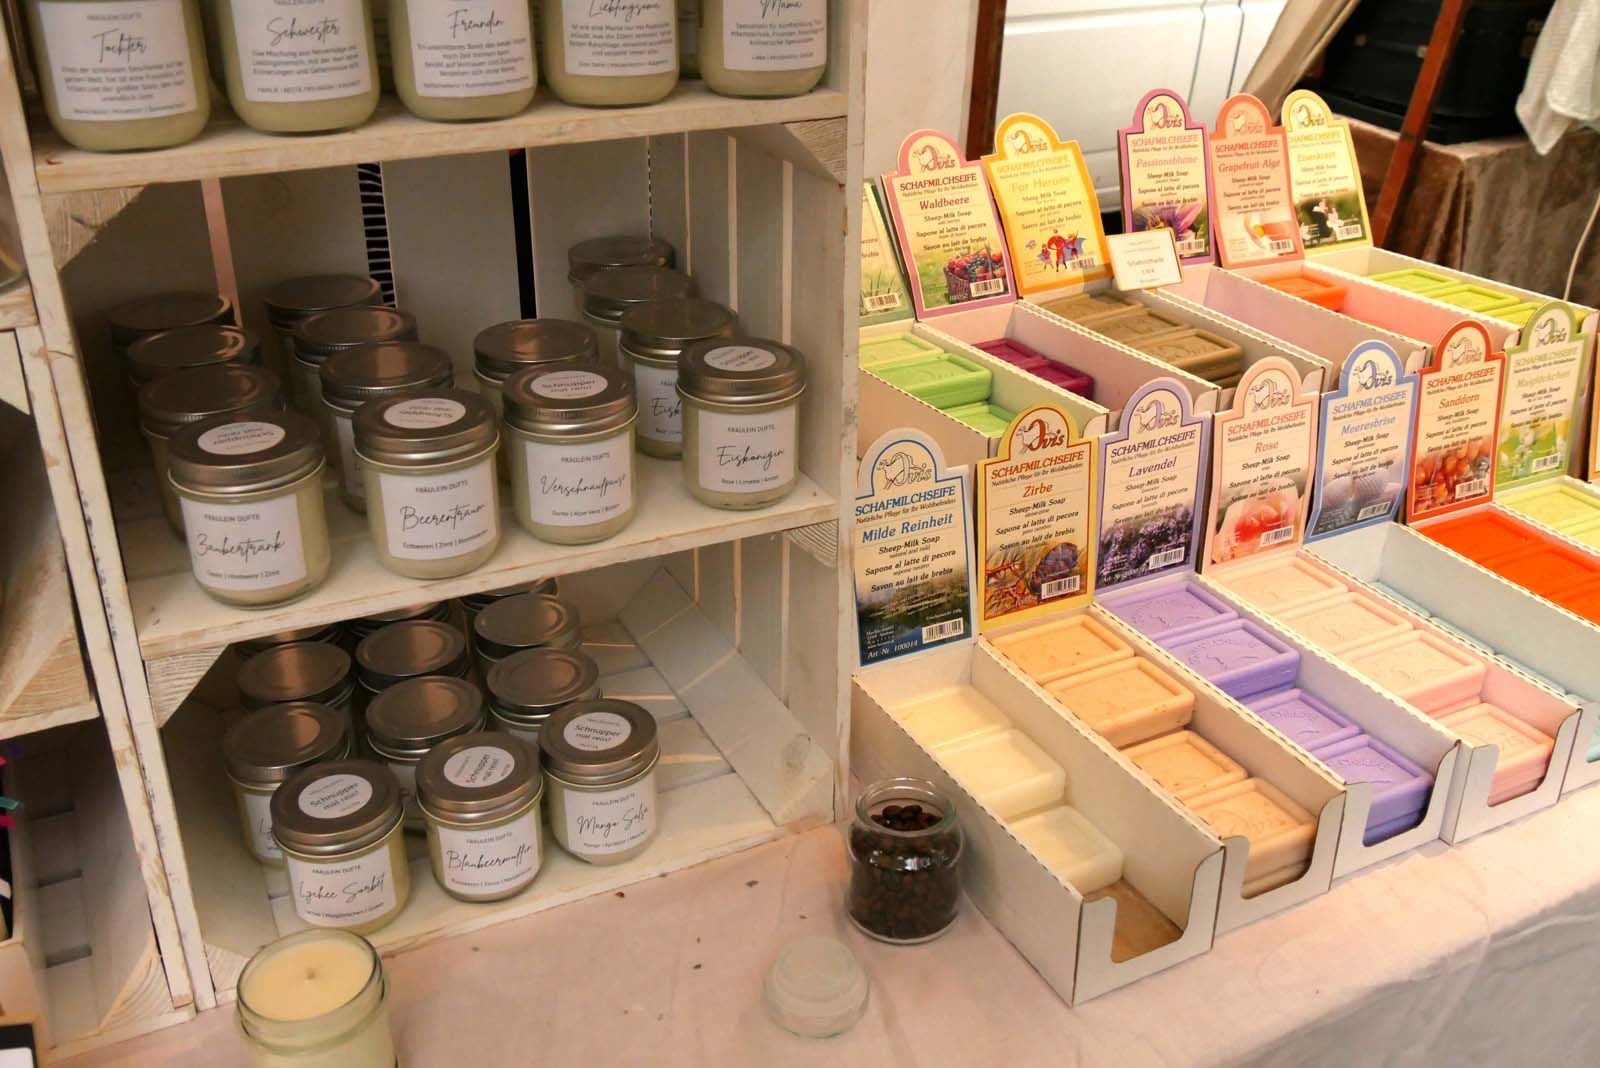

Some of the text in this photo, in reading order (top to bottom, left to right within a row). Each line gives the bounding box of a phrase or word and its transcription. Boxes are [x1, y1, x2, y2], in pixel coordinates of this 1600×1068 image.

[267, 17, 340, 47] Schwester
[448, 9, 505, 40] Freundin
[92, 28, 148, 62] Tochter
[1156, 103, 1182, 129] Ovis
[1299, 104, 1325, 127] Ovis
[1015, 130, 1048, 154] Ovis
[1131, 134, 1200, 147] SCHAFMILCHSEIFE
[1215, 140, 1278, 154] SCHAFMILCHSEIFE
[919, 145, 956, 172] Ovis
[996, 154, 1070, 173] SCHAFMILCHSEIFE
[1218, 160, 1260, 173] Grapefruit
[900, 173, 977, 192] SCHAFMILCHSEIFE
[919, 196, 970, 211] Waldbeere
[1540, 318, 1567, 346] Ovis
[1514, 347, 1578, 367] SCHAFMILCHSEIFE
[1362, 360, 1392, 390] Ovis
[1426, 366, 1496, 390] SCHAFMILCHSEIFE
[1259, 379, 1290, 410] Ovis
[1332, 390, 1407, 415] SCHAFMILCHSEIFE
[1439, 394, 1480, 409] Sanddorn
[756, 424, 775, 432] DUFTE
[1145, 400, 1178, 431] Ovis
[1226, 410, 1306, 436] SCHAFMILCHSEIFE
[1341, 416, 1397, 434] Meeresbrise
[1024, 418, 1064, 451] Ovis
[1110, 429, 1197, 458] SCHAFMILCHSEIFE
[1254, 440, 1280, 454] Rose
[890, 452, 932, 487] Ovis
[992, 450, 1086, 480] SCHAFMILCHSEIFE
[1128, 456, 1178, 478] Lavendel
[1023, 482, 1054, 498] Zirbe
[1160, 474, 1178, 484] Soap
[855, 486, 957, 517] SCHAFMILCHSEIFE
[1009, 497, 1067, 516] Sheep-Milk Soap
[400, 503, 486, 532] Beerentraum
[862, 513, 954, 544] Milde Reinheit
[995, 510, 1080, 536] Sapone al latte di pecora
[194, 530, 286, 564] Zaubertrank
[879, 536, 942, 556] Sheep-Milk Soap
[1032, 534, 1044, 544] lait
[1044, 531, 1054, 540] de
[1055, 526, 1076, 538] brebis
[865, 550, 957, 577] Sapone al latte di pecora
[870, 567, 954, 594] Savon au lait de brebis
[310, 782, 359, 808] Schnupper
[576, 803, 648, 838] Mango Salsa
[446, 843, 532, 872] Blaubeermuffin
[298, 873, 386, 904] Lychee Sorbet
